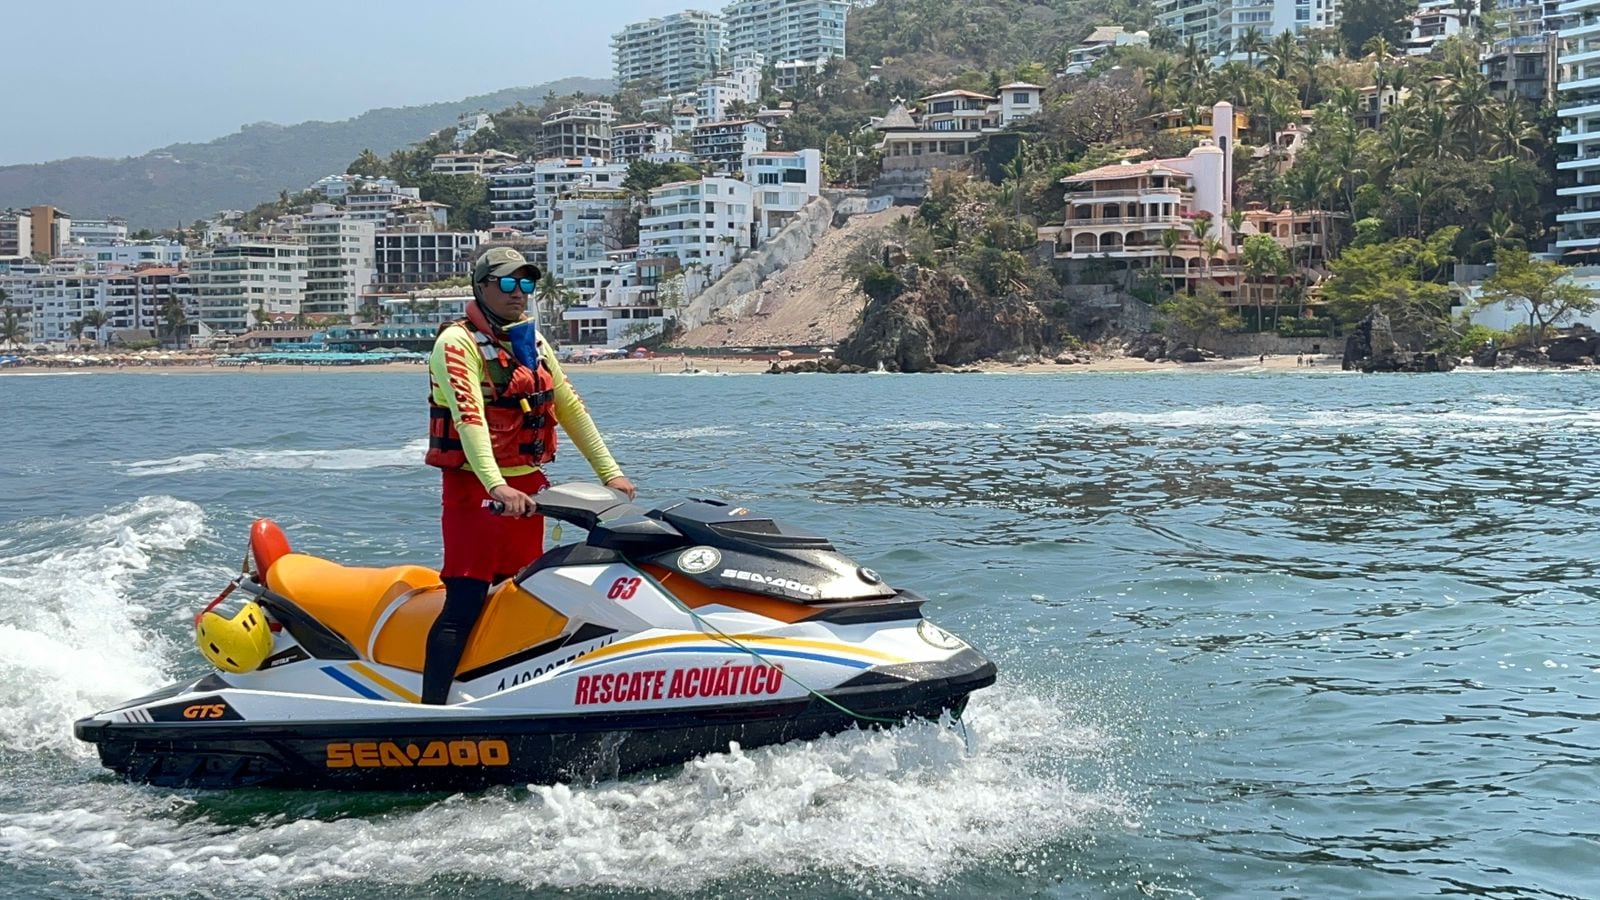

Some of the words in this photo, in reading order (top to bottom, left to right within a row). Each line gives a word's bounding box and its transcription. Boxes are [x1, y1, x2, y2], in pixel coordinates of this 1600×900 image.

[444, 342, 483, 426] RESCATE
[606, 576, 641, 600] 63
[574, 670, 666, 705] RESCATE
[667, 660, 784, 699] ACUÁTICO
[183, 703, 226, 719] GTS
